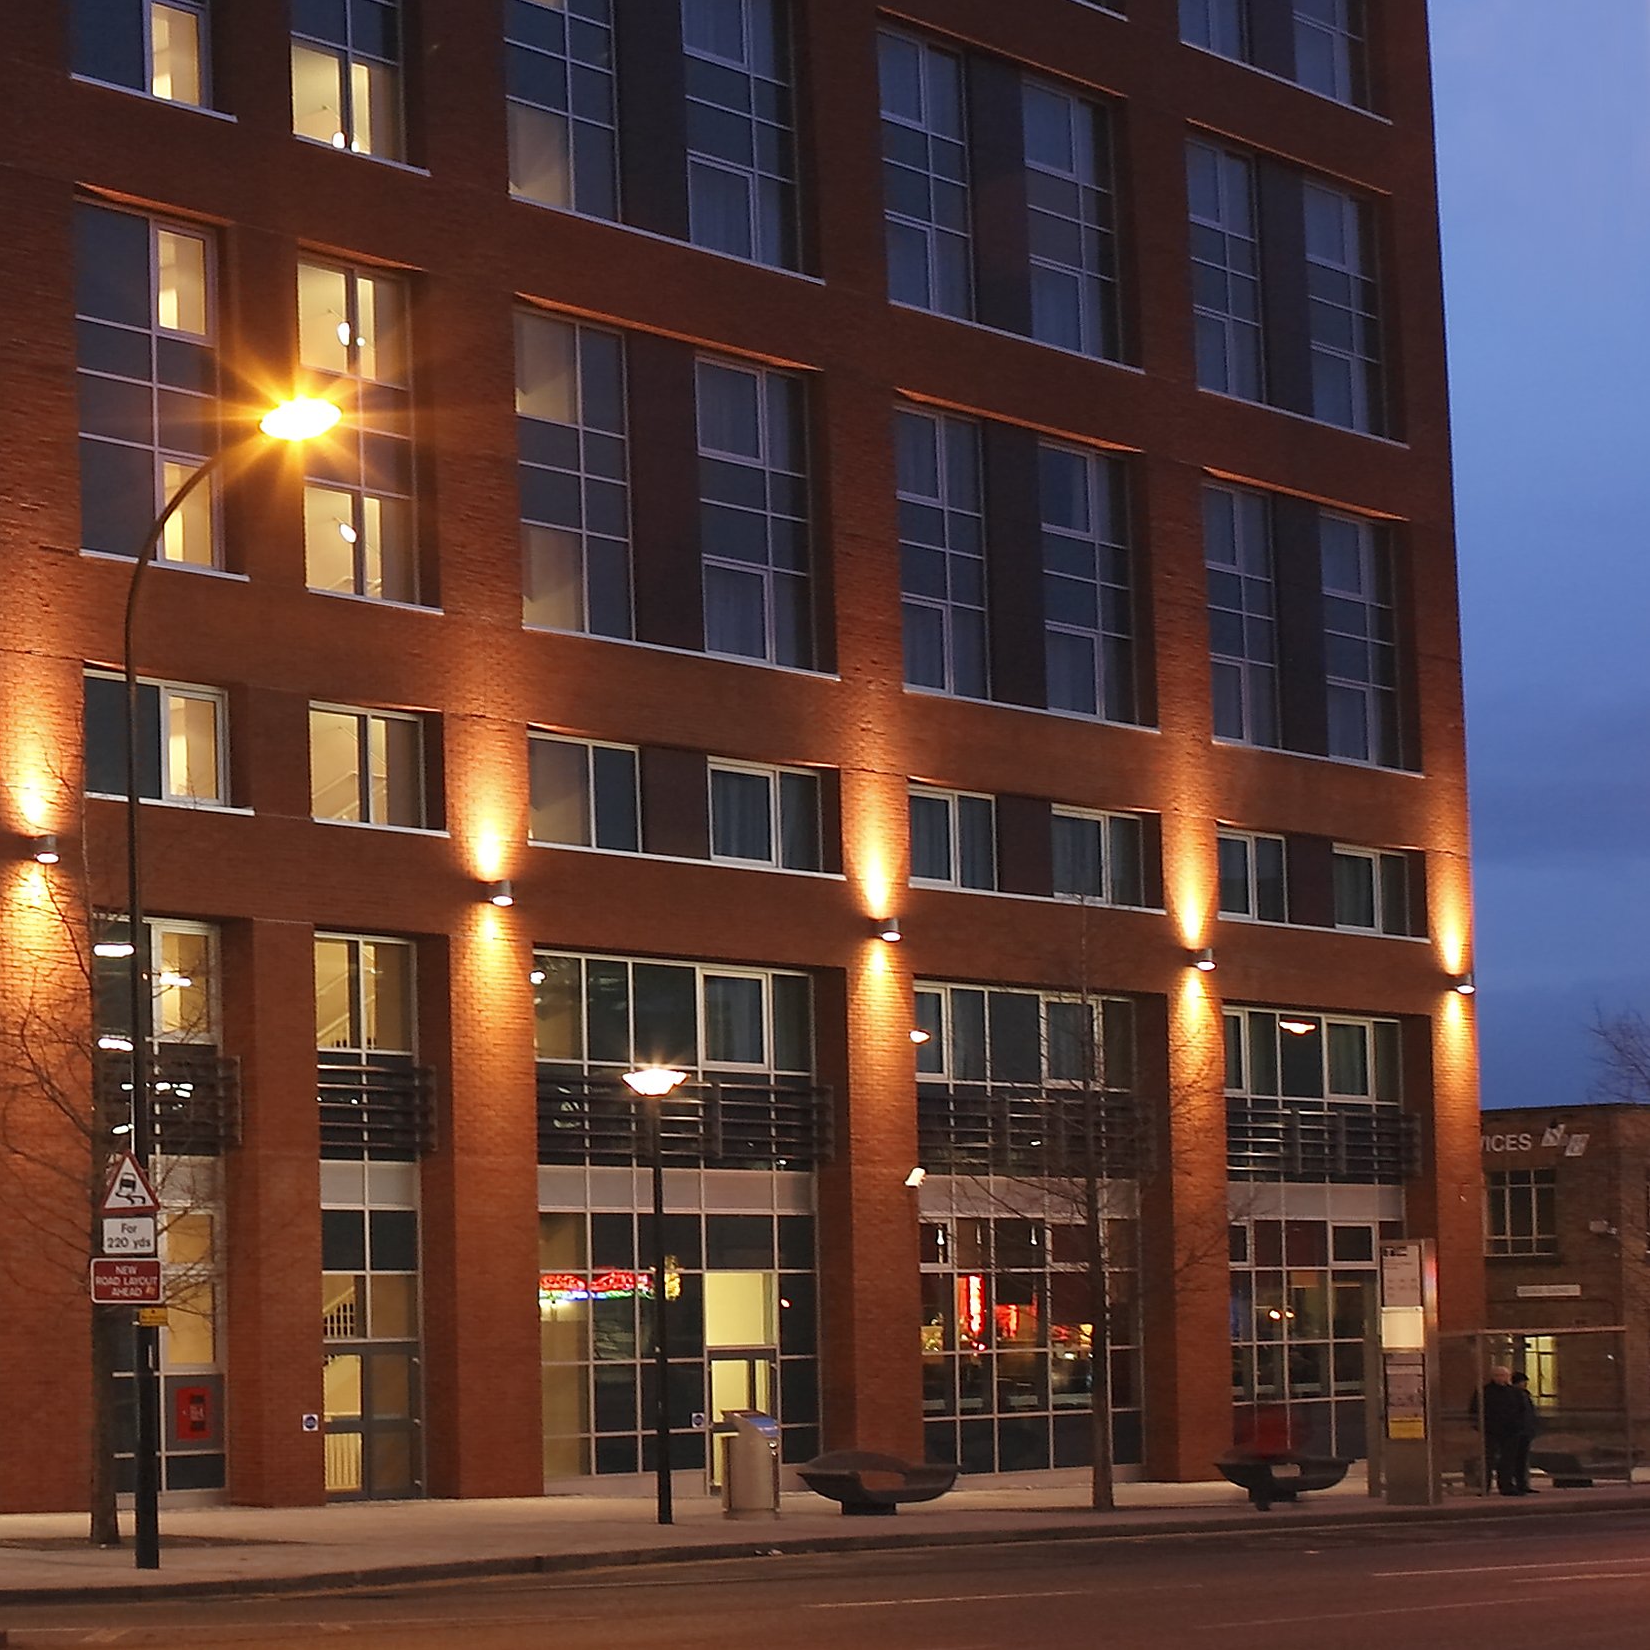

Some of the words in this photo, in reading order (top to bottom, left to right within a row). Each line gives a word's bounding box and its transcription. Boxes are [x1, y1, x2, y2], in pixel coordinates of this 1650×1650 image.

[121, 1223, 138, 1233] For
[107, 1237, 129, 1248] 220
[133, 1237, 151, 1249] yds
[115, 1265, 137, 1275] NEW
[95, 1276, 121, 1286] ROAD
[123, 1276, 158, 1286] LAYOUT
[111, 1287, 142, 1297] AHEAD
